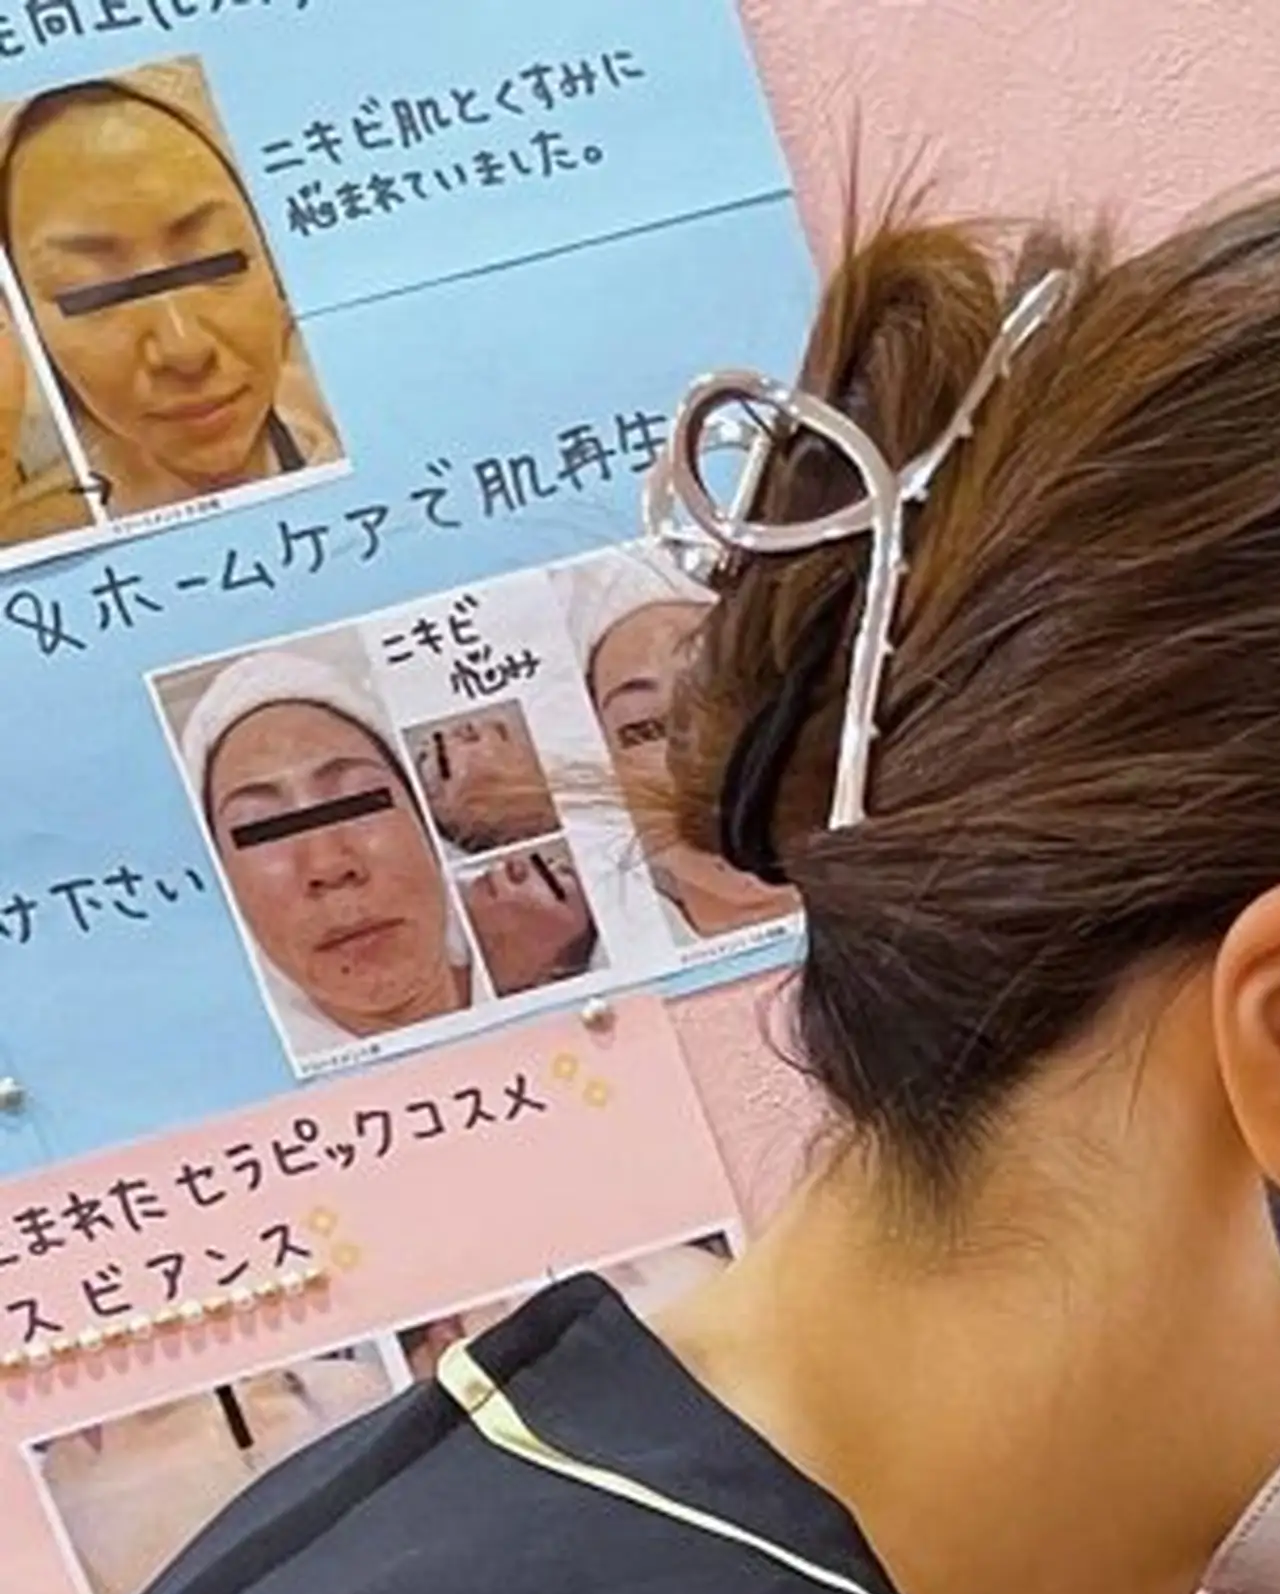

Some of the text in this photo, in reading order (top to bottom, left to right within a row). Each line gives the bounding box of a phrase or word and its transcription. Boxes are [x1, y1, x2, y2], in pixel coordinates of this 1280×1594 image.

[261, 50, 645, 174] ニキビ肌とくすみに
[286, 130, 603, 236] 悩まれていました。
[382, 595, 480, 665] ニキビ
